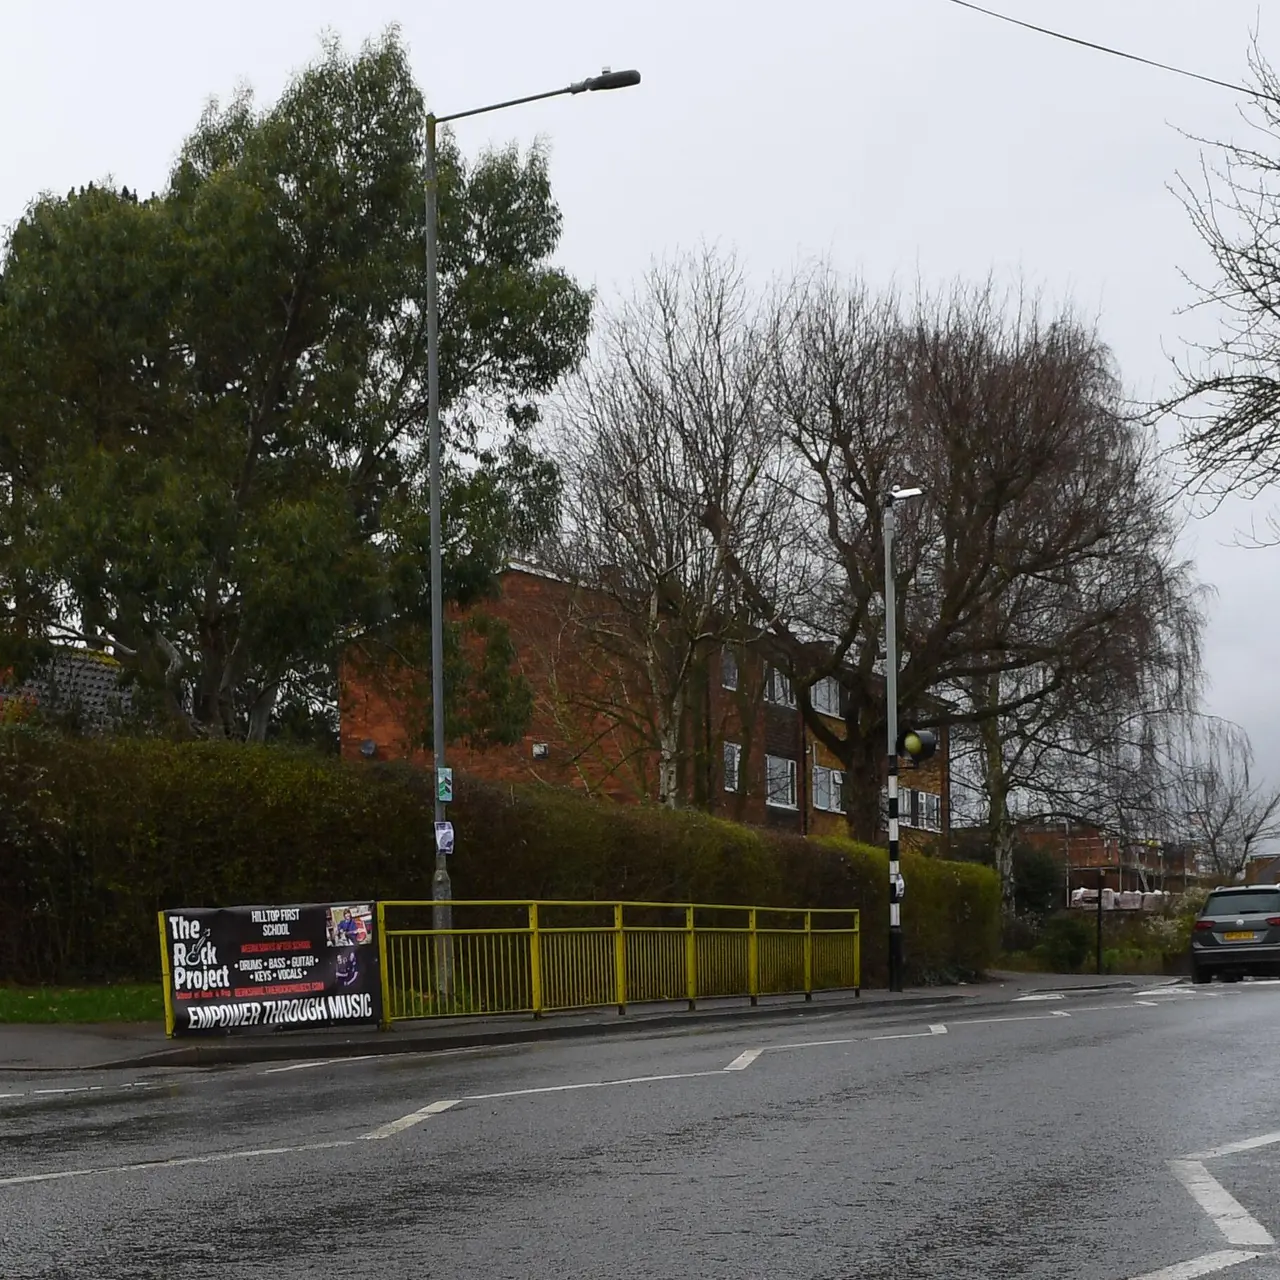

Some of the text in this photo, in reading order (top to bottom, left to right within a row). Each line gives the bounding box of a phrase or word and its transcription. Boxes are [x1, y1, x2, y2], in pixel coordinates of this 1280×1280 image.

[251, 908, 300, 923] HILLTOP FIRST
[169, 916, 201, 940] The
[262, 923, 291, 936] SCHOOL
[239, 956, 315, 971] DRUMS BASS GUITAR
[173, 965, 230, 990] Project
[254, 968, 303, 982] KEYS VOCALS
[187, 992, 373, 1029] EMPOWER THROUGH MUSIC
